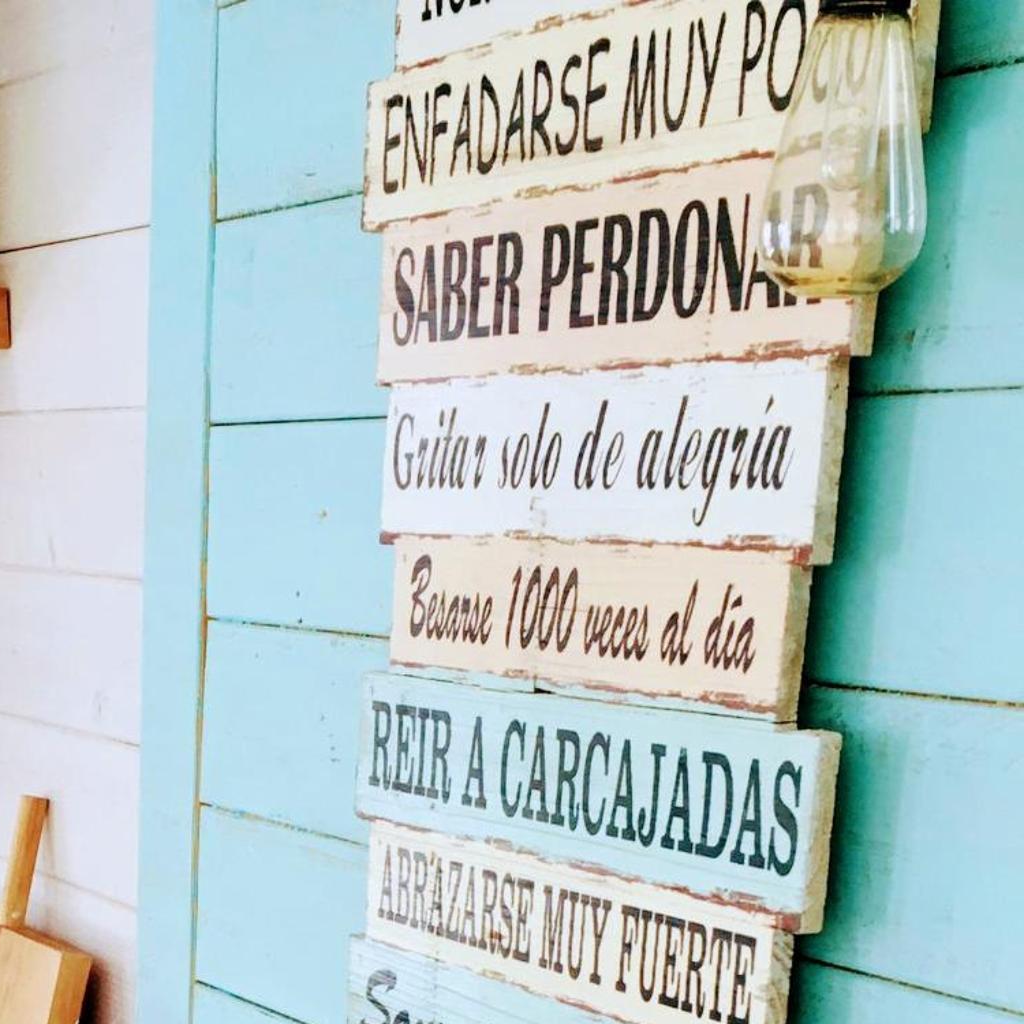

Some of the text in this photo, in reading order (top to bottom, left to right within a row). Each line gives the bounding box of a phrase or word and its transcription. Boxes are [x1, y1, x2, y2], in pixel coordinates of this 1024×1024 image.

[382, 37, 611, 194] ENFADARSE
[620, 11, 726, 144] MUY
[392, 230, 524, 347] SABER
[393, 395, 794, 527] Gritar solo de alegría
[410, 554, 757, 674] Besarse 1000 veces al día
[368, 700, 804, 877] REIR A CARCAJADAS
[538, 885, 613, 986] MUY
